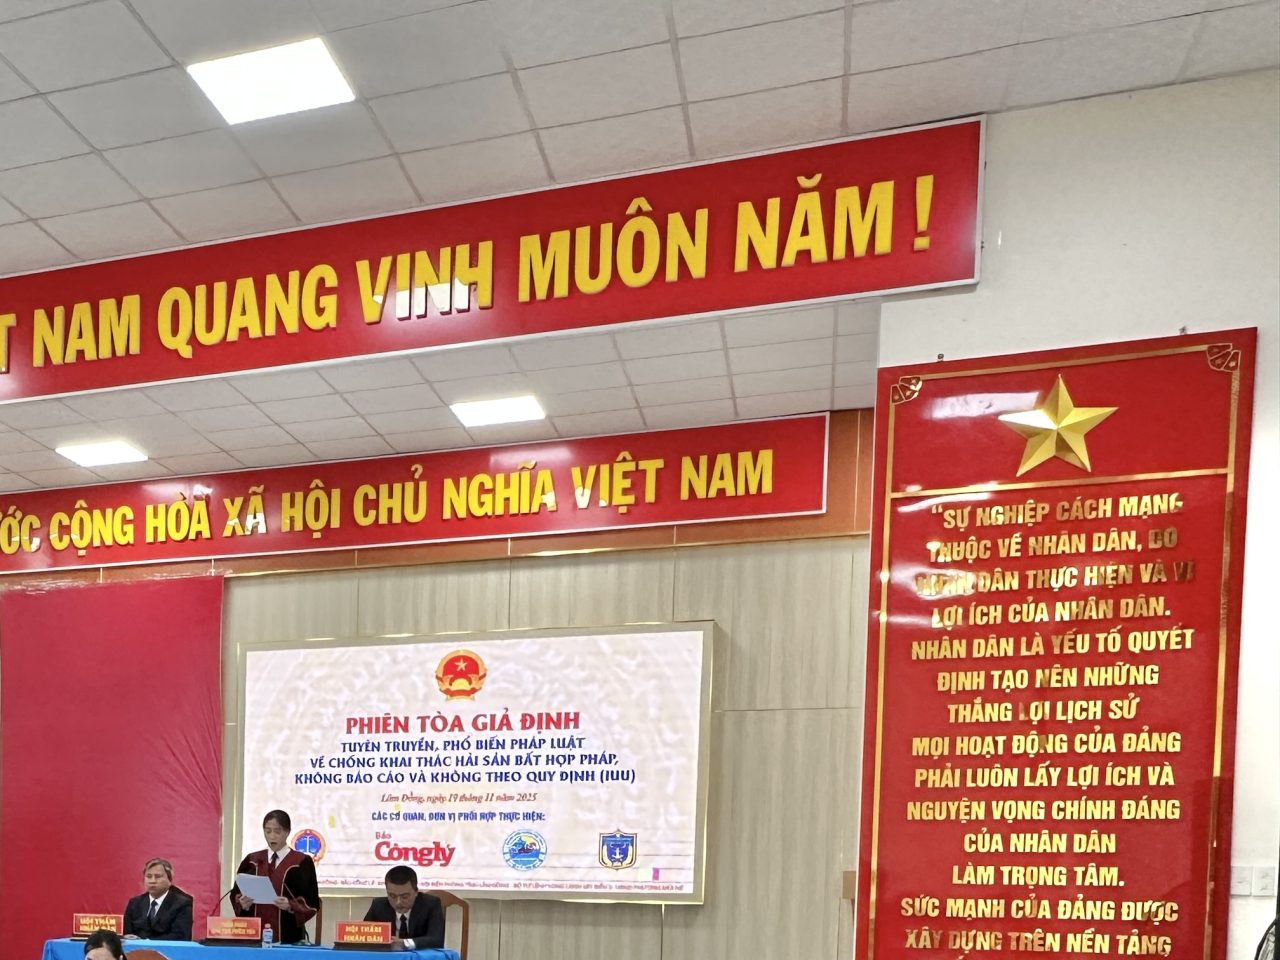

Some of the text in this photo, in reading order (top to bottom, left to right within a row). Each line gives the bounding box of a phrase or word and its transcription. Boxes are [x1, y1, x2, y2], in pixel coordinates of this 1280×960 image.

[32, 294, 142, 367] NAM
[157, 264, 337, 360] QUANG
[356, 240, 494, 325] VINH
[518, 197, 709, 302] MUÔN
[734, 173, 895, 273] NĂM
[912, 175, 934, 251] !
[50, 500, 134, 556] CỘNG
[145, 491, 211, 543] HÒA
[223, 484, 268, 538] XÃ
[281, 478, 341, 539] HỘI
[353, 463, 428, 526] CHỦ
[442, 459, 557, 520] NGHĨA
[571, 451, 664, 514] VIỆT
[680, 449, 773, 501] NAM
[976, 499, 1050, 527] NGHIỆP
[1056, 497, 1112, 522] CÁCH
[1119, 492, 1183, 519] MẠNG
[969, 602, 1003, 625] ÍCH
[1008, 595, 1049, 622] CỦA
[1054, 597, 1114, 622] NHÂN
[1120, 594, 1171, 618] DÂN.
[911, 622, 1195, 660] NHÂN DÂN LÀ YẾU TỐ QUYẾT
[937, 661, 1159, 695] ĐỊNH TẠO NÊN NHỮNG
[346, 707, 580, 734] PHIÊN TÒA GIẢ ĐỊNH
[947, 692, 1140, 725] THẮNG LỢI LỊCH SỬ
[510, 735, 546, 749] PHÁP
[912, 725, 1182, 760] MỌI HOẠT ĐỘNG CỦA ĐẢNG
[380, 756, 412, 768] KHAI
[416, 754, 452, 767] THÁC
[455, 752, 478, 767] HẢI
[482, 752, 511, 766] SẢN
[545, 752, 576, 767] HỢP
[914, 761, 1175, 790] PHẢI LUÔN LẤY LỢI ÍCH VÀ
[346, 770, 373, 783] BÁO
[377, 769, 405, 783] CÁO
[409, 768, 427, 783] VÀ
[485, 771, 521, 782] THEO
[526, 771, 556, 784] QUY
[559, 770, 595, 783] ĐỊNH
[599, 769, 636, 784] (IUU)
[906, 795, 1180, 823] NGUYỆN VỌNG CHÍNH ĐÁNG
[963, 827, 1116, 853] CỦA NHÂN DÂN
[952, 862, 1125, 889] LÀM TRỌNG TÂM.
[901, 893, 1179, 925] SỨC MẠNH CỦA ĐẢNG ĐƯỢC
